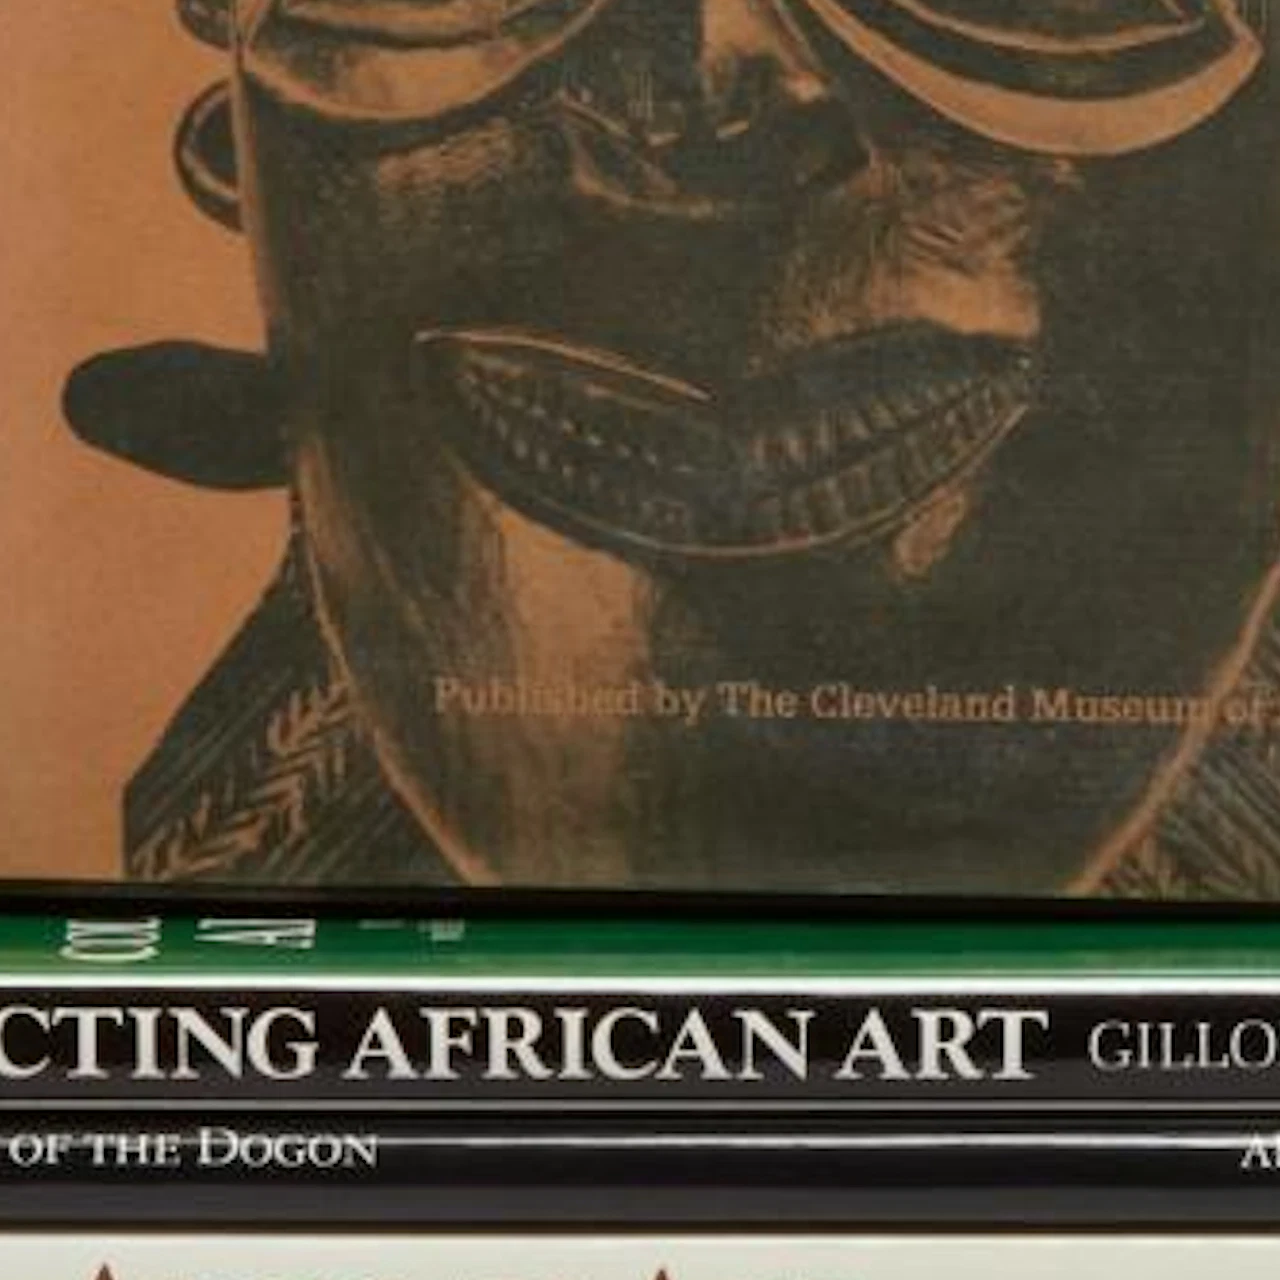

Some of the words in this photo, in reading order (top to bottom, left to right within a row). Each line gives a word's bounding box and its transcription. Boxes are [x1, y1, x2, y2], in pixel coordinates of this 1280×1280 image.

[432, 675, 641, 717] Published
[653, 679, 707, 725] by
[717, 680, 801, 718] The
[810, 681, 1016, 721] Cleveland
[1031, 687, 1213, 723] Museum
[1225, 686, 1268, 725] of
[341, 1005, 815, 1082] AFRICAN
[836, 1006, 1050, 1082] ART
